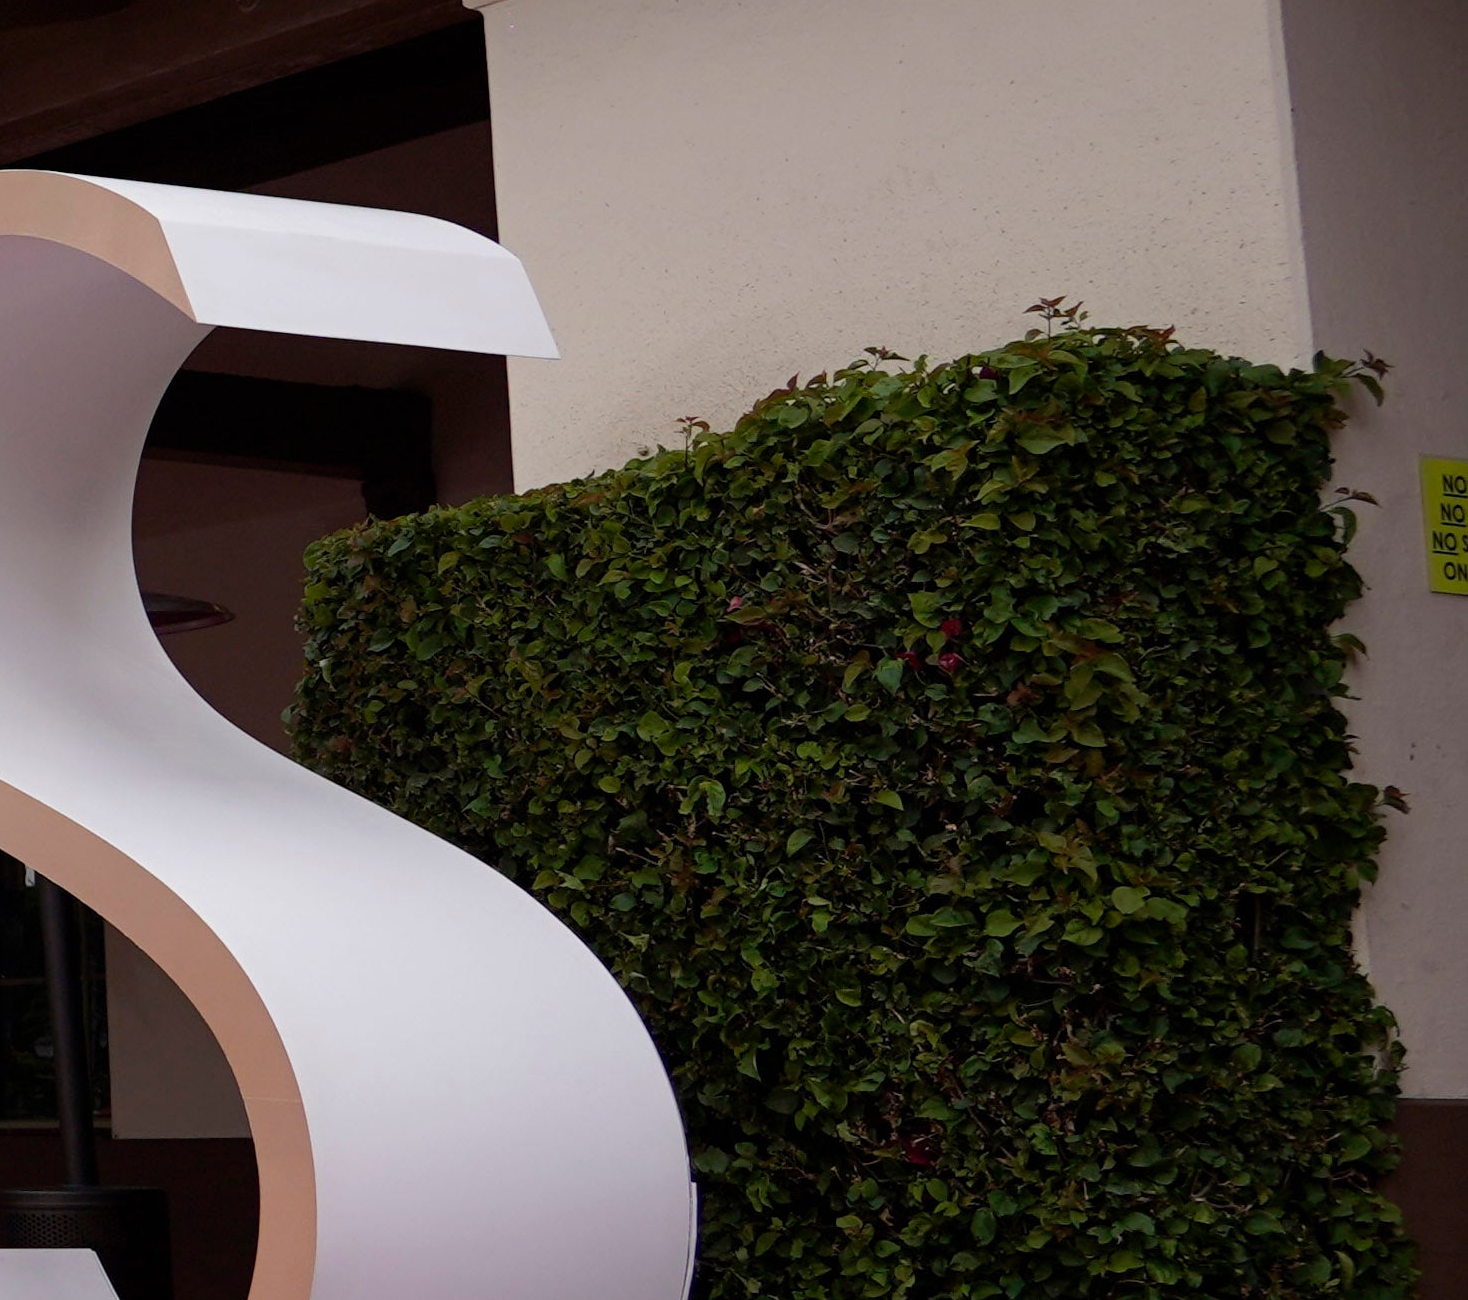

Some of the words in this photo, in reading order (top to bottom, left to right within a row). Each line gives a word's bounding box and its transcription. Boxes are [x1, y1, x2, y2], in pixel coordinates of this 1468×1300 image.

[1442, 474, 1467, 495] NO
[1440, 502, 1465, 523] NO
[1432, 530, 1457, 551] NO
[1443, 561, 1468, 582] ON
